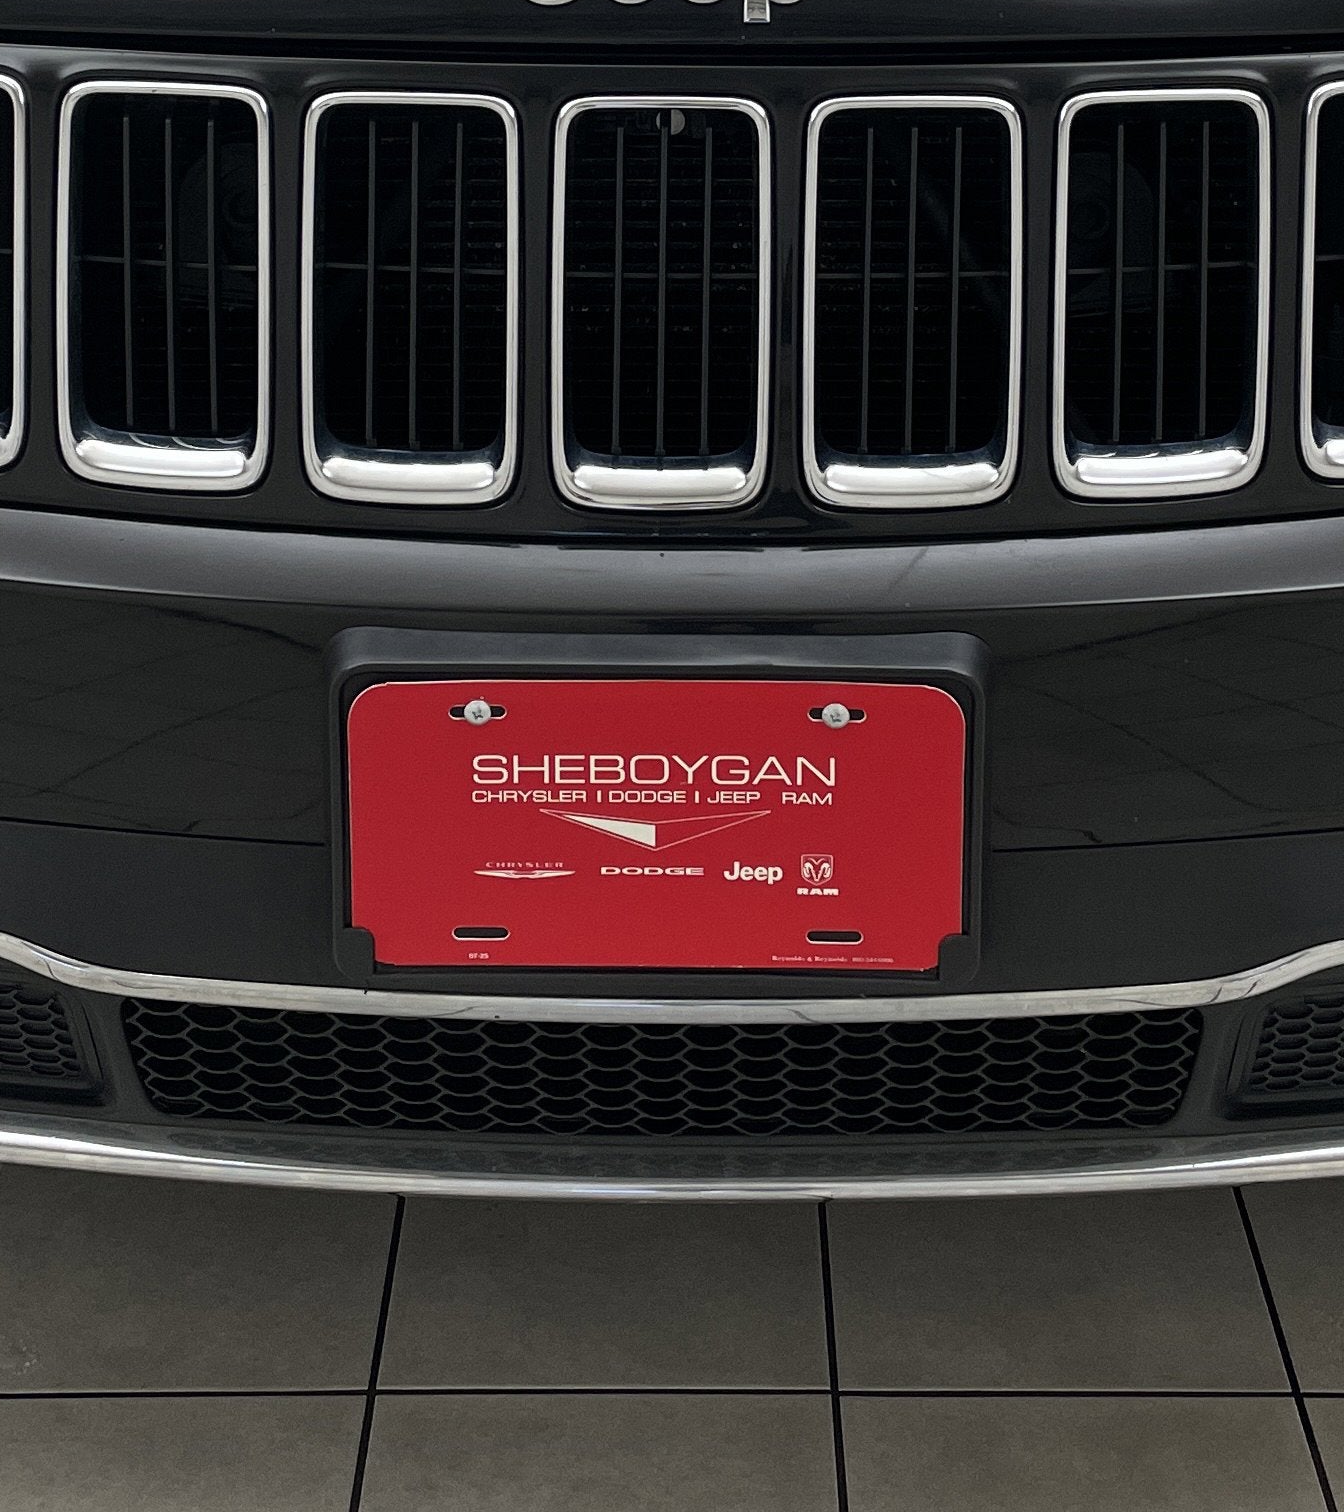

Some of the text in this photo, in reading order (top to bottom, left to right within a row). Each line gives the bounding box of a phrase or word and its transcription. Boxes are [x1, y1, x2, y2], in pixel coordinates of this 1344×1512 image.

[472, 754, 836, 787] SHEBOYGAN
[471, 789, 587, 803] CHRYSLER
[608, 790, 687, 804] DODGE
[706, 790, 761, 804] JEEP
[781, 791, 833, 806] RAM
[600, 866, 705, 876] DODGE
[723, 861, 784, 885] Jeep
[796, 887, 840, 896] RAM
